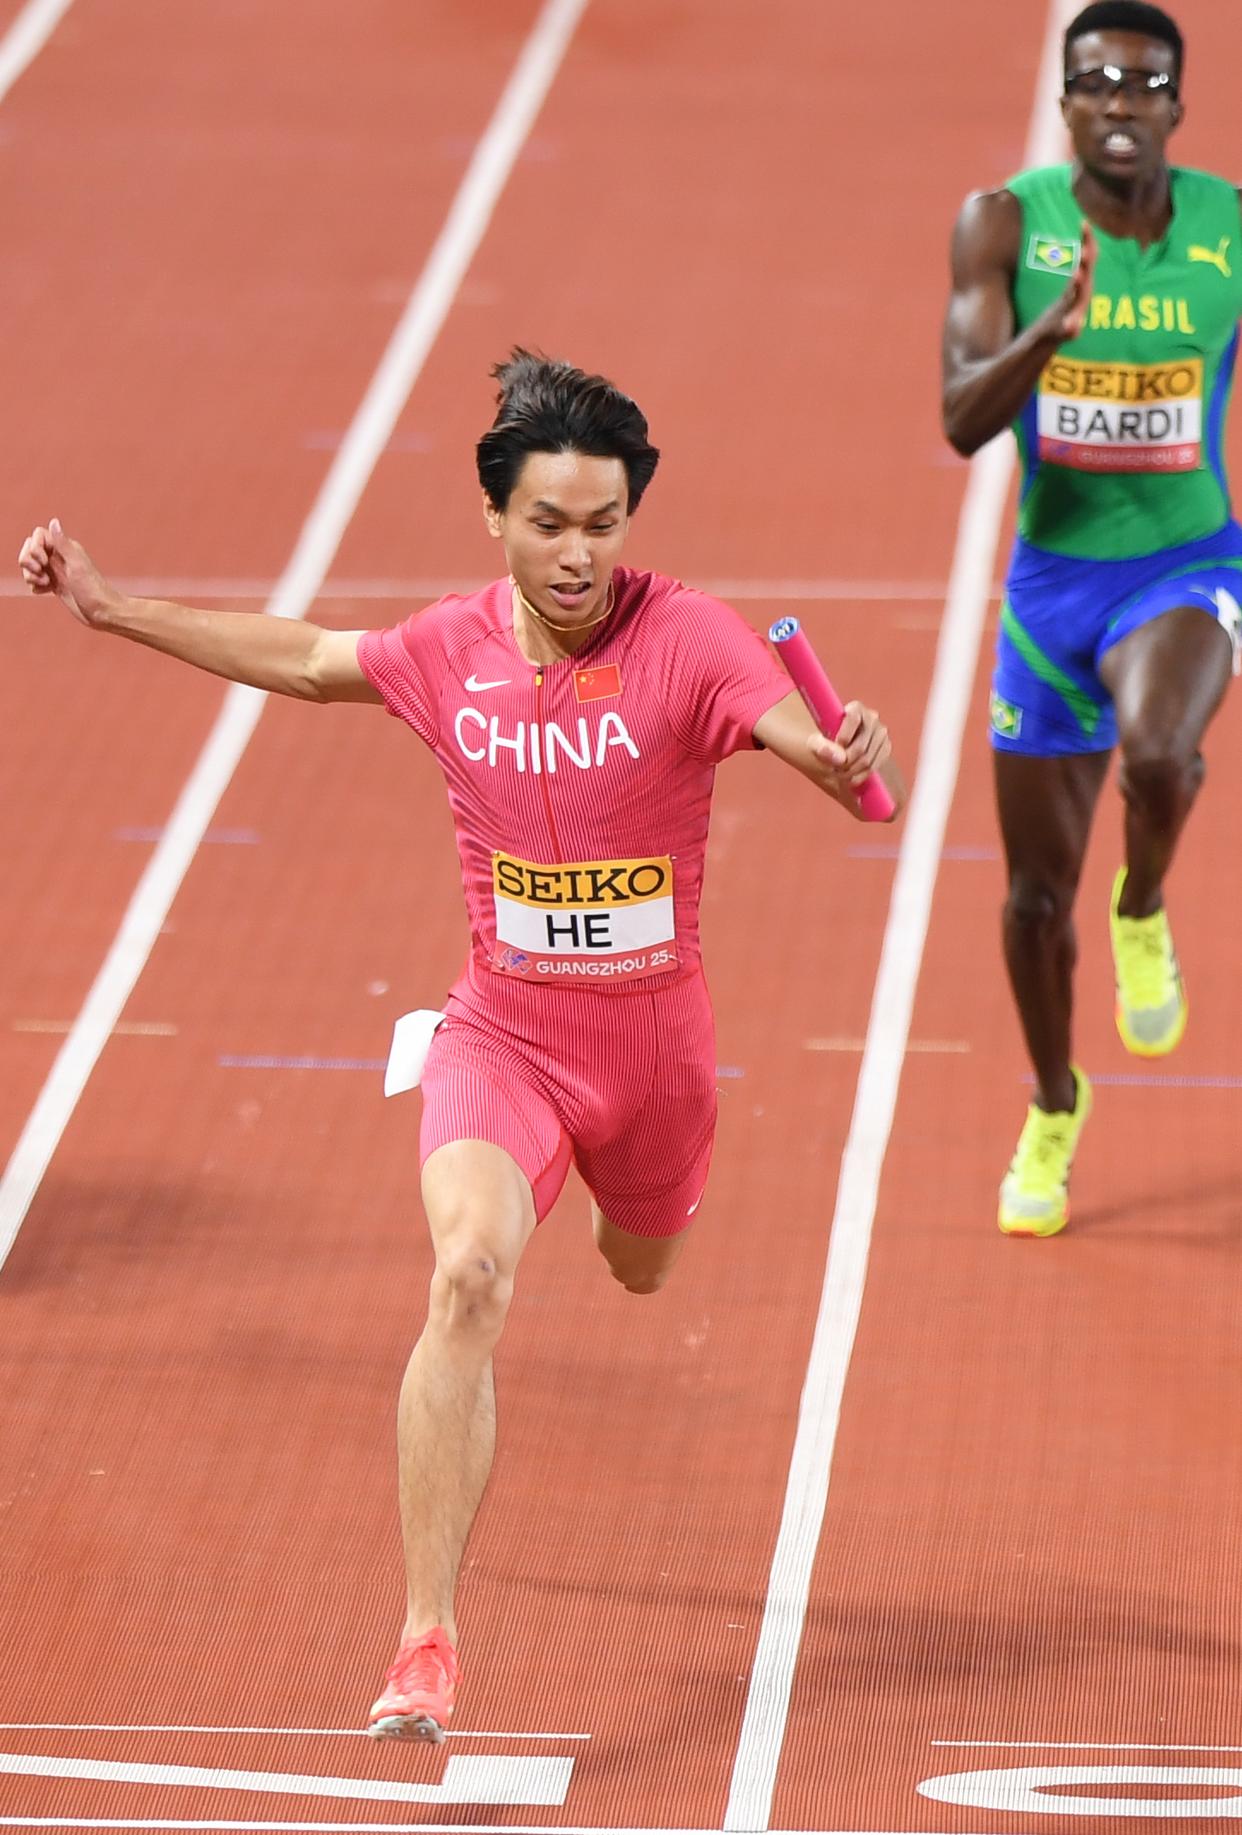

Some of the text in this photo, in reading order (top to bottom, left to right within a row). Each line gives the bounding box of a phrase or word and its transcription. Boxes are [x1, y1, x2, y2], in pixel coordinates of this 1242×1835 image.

[1082, 294, 1195, 334] RASIL
[1049, 366, 1195, 400] SEIKO
[1057, 405, 1184, 440] BARDI
[454, 706, 640, 774] CHINA
[496, 859, 665, 903] SEIKO
[545, 913, 612, 948] HE
[536, 949, 669, 976] GUANGZHOU 25
